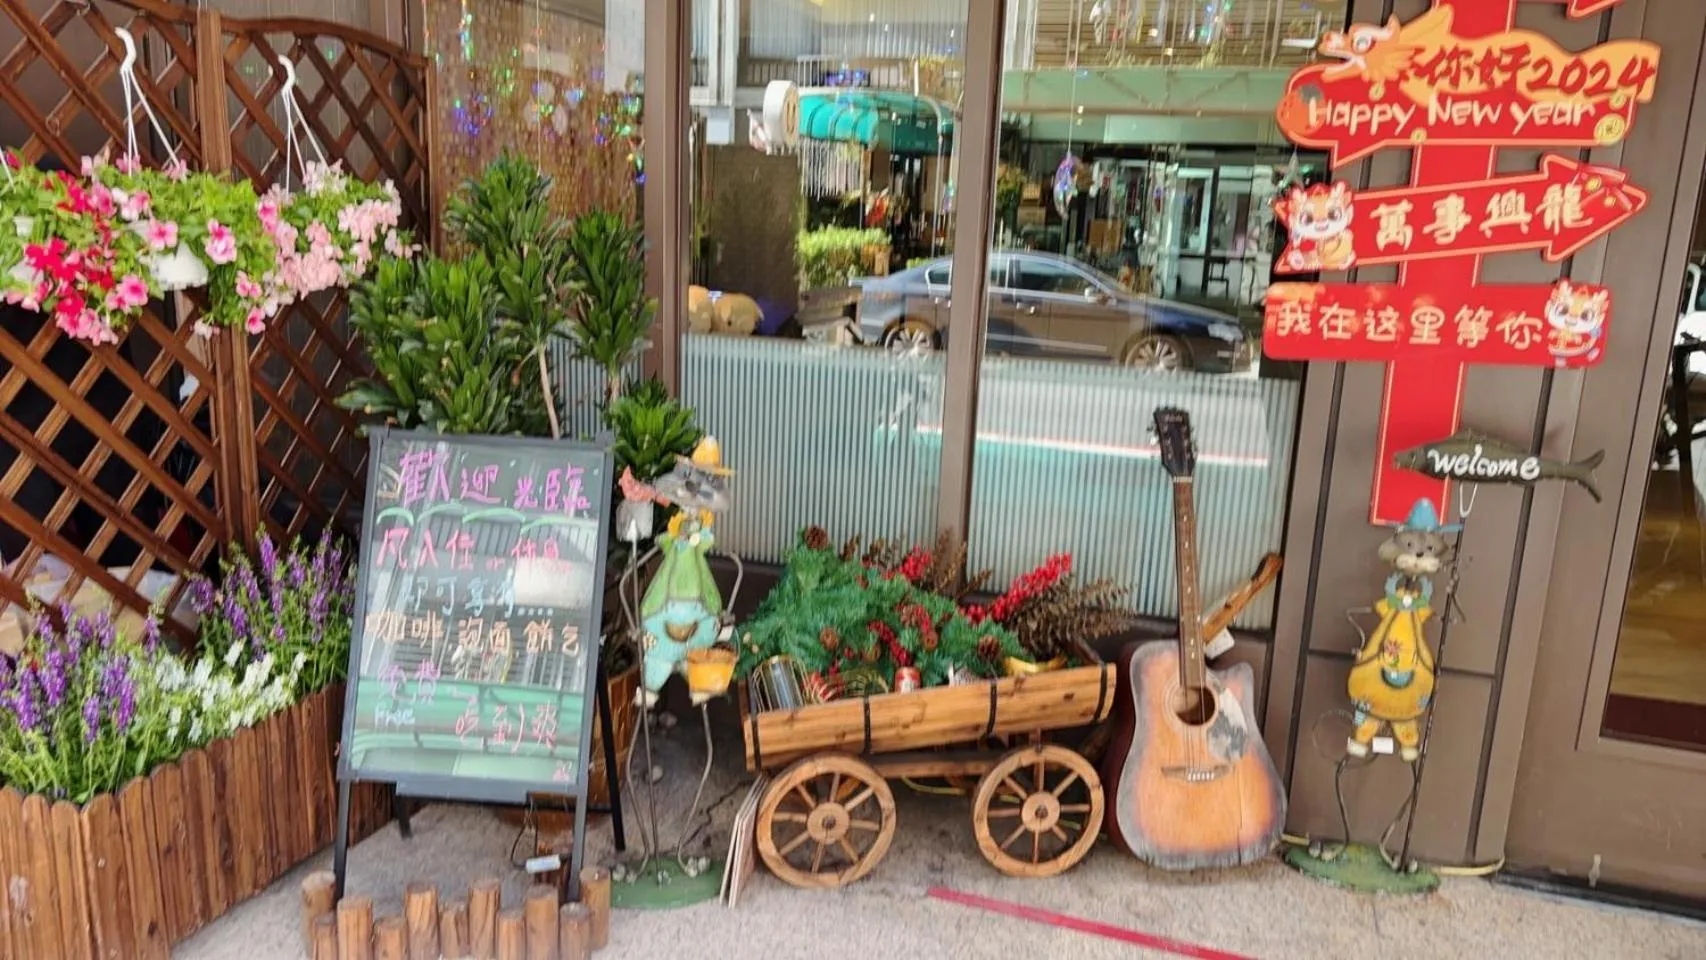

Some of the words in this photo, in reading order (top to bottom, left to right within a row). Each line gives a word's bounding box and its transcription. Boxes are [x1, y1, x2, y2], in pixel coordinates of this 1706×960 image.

[1308, 96, 1415, 136] Happy
[1428, 93, 1502, 127] New
[1509, 99, 1597, 136] year
[1370, 183, 1594, 251] 萬事興龍
[1276, 298, 1544, 349] 我在这里等你
